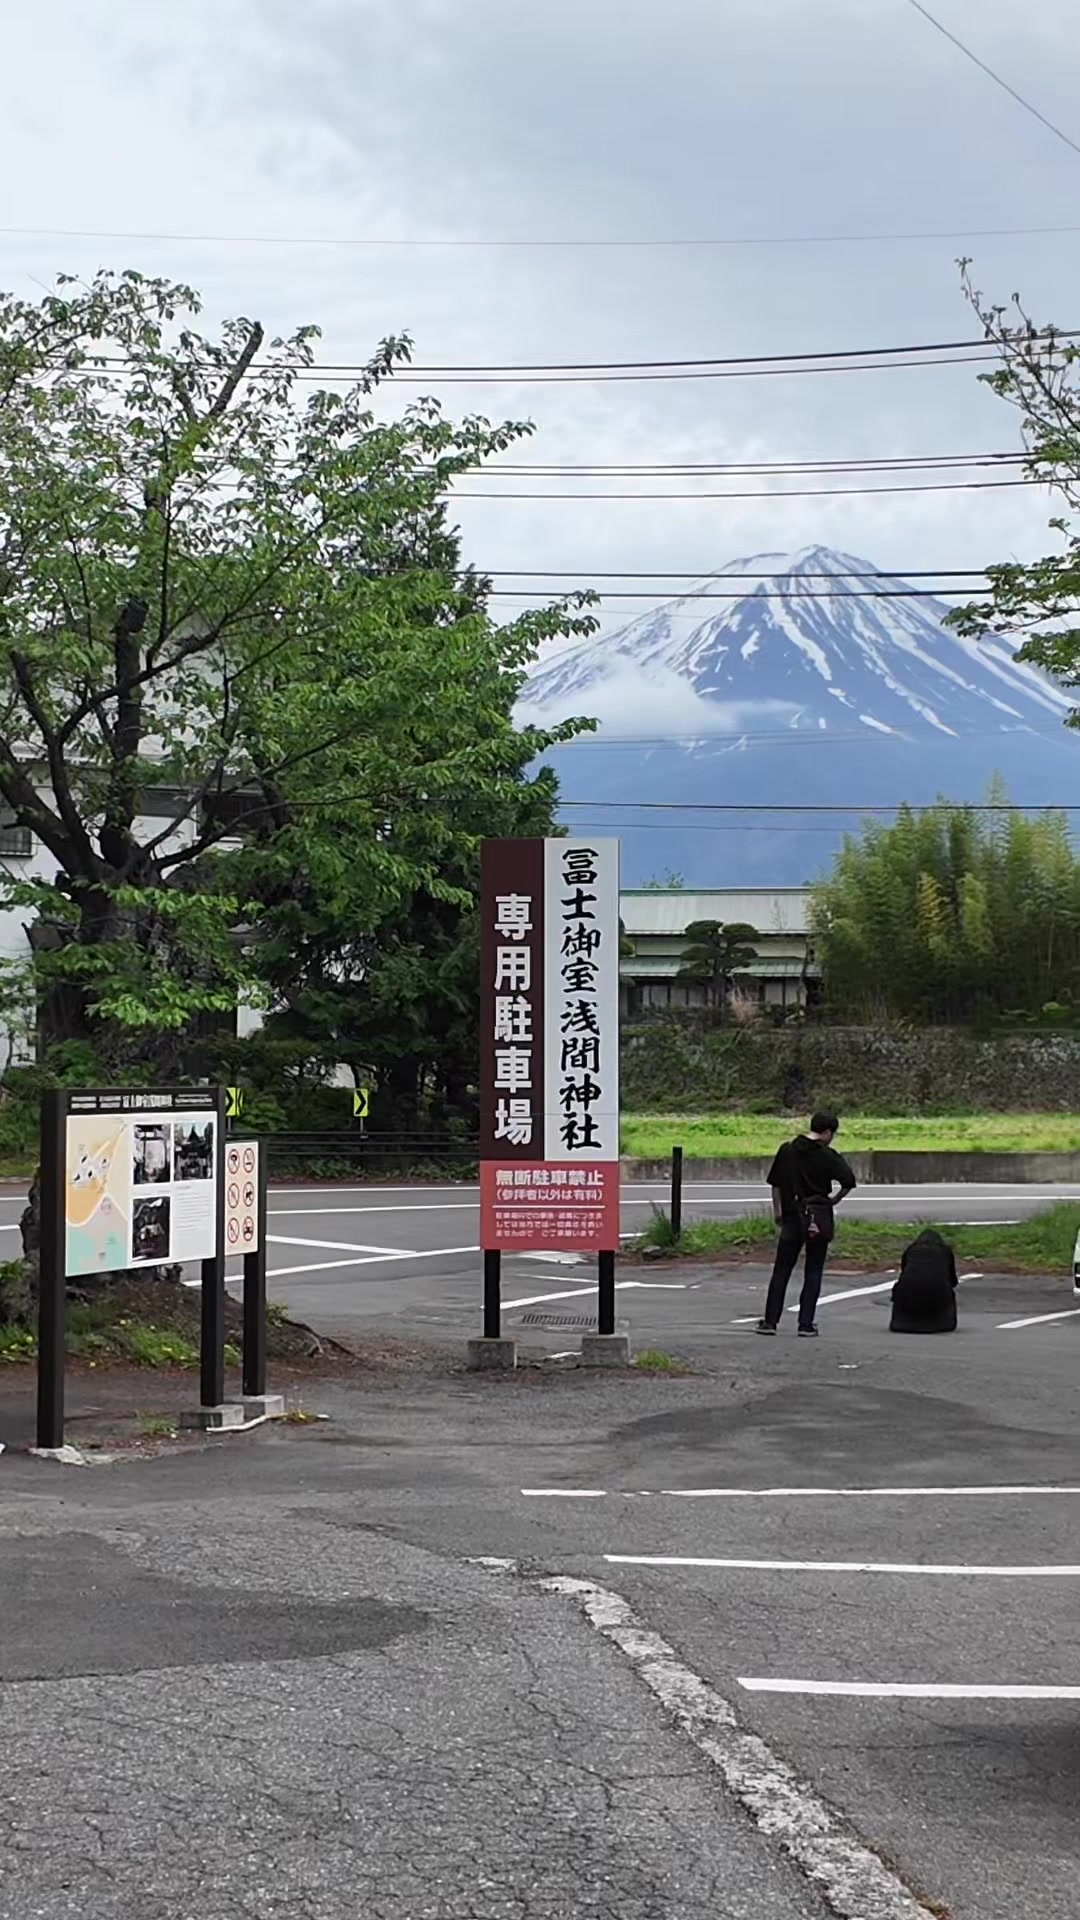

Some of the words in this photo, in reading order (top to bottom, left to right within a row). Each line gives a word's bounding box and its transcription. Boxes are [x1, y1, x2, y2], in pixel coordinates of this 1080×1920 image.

[494, 893, 533, 1145] 専用駐車場
[496, 1170, 604, 1186] 無断駐車禁止
